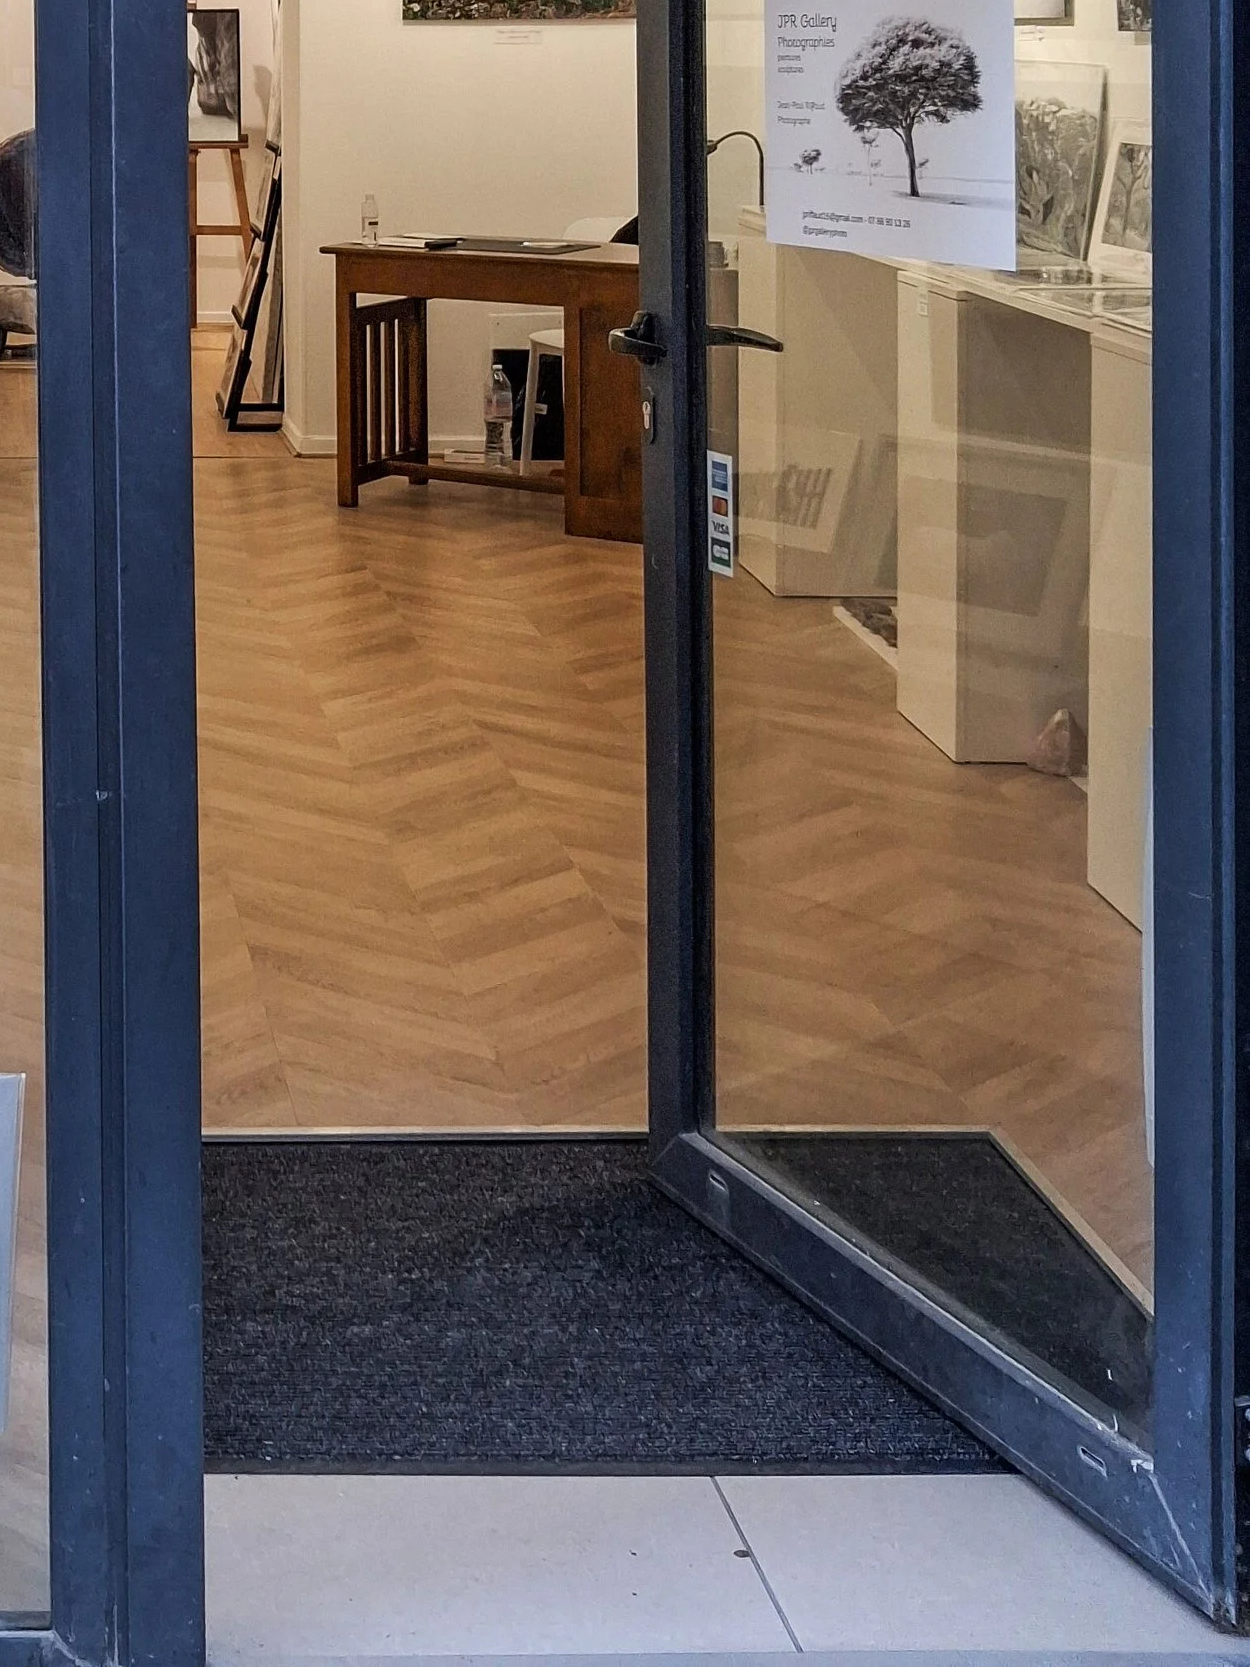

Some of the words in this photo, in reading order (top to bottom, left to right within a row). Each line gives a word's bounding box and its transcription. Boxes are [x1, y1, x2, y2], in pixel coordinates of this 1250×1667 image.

[777, 14, 797, 28] JPR
[800, 13, 837, 32] Gallery
[777, 36, 835, 51] Photographies
[711, 519, 730, 535] VISA
